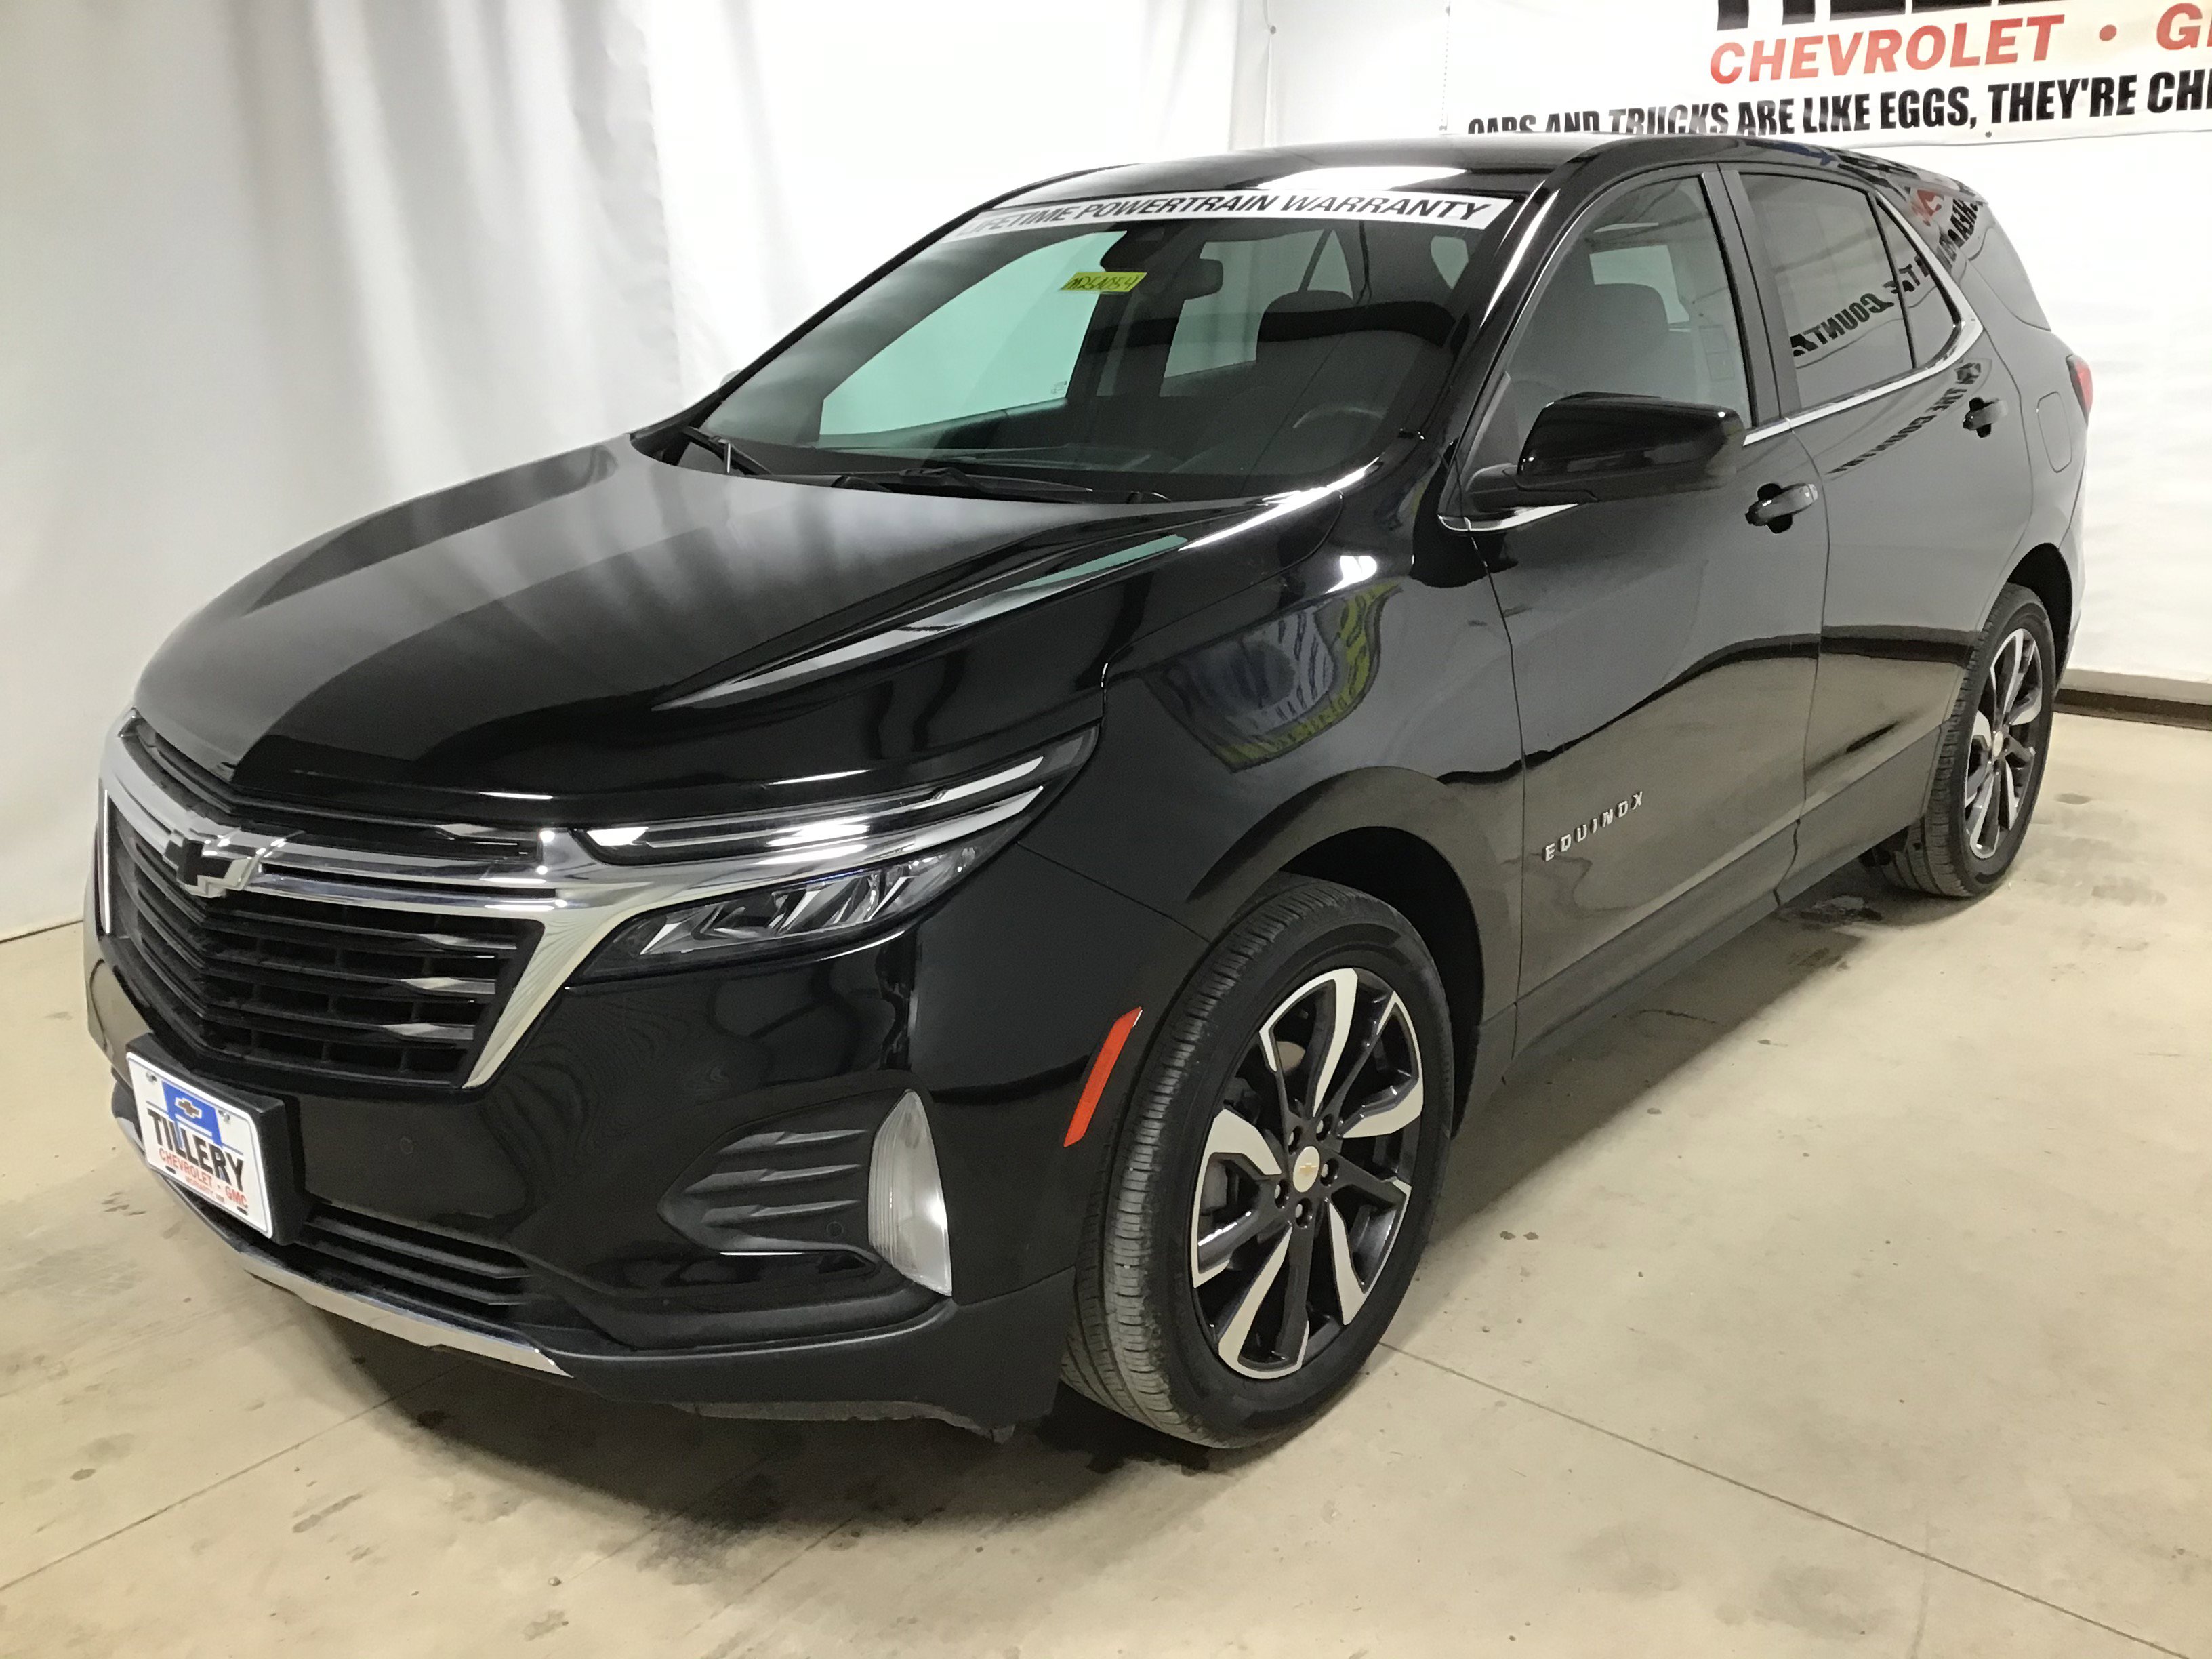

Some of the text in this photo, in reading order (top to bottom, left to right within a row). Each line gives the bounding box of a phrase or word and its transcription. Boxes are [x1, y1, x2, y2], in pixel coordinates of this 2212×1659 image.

[1710, 14, 2065, 85] CHEVROLET
[2156, 2, 2212, 51] G
[1545, 110, 1600, 133] AND
[1608, 102, 1729, 135] TRUCKS
[1736, 98, 1795, 136] ARE
[1803, 93, 1870, 133] LIKE
[1880, 85, 1977, 130] EGGS,
[1987, 73, 2137, 124] THEY'RE
[2147, 68, 2212, 114] CH
[957, 194, 1492, 236] LIFETIME POWERTRAIN WARRANTY
[1542, 791, 1643, 862] EQUINOX
[146, 1107, 244, 1192] TILLERY
[159, 1147, 212, 1189] CHEVROLET
[225, 1185, 248, 1209] GMC
